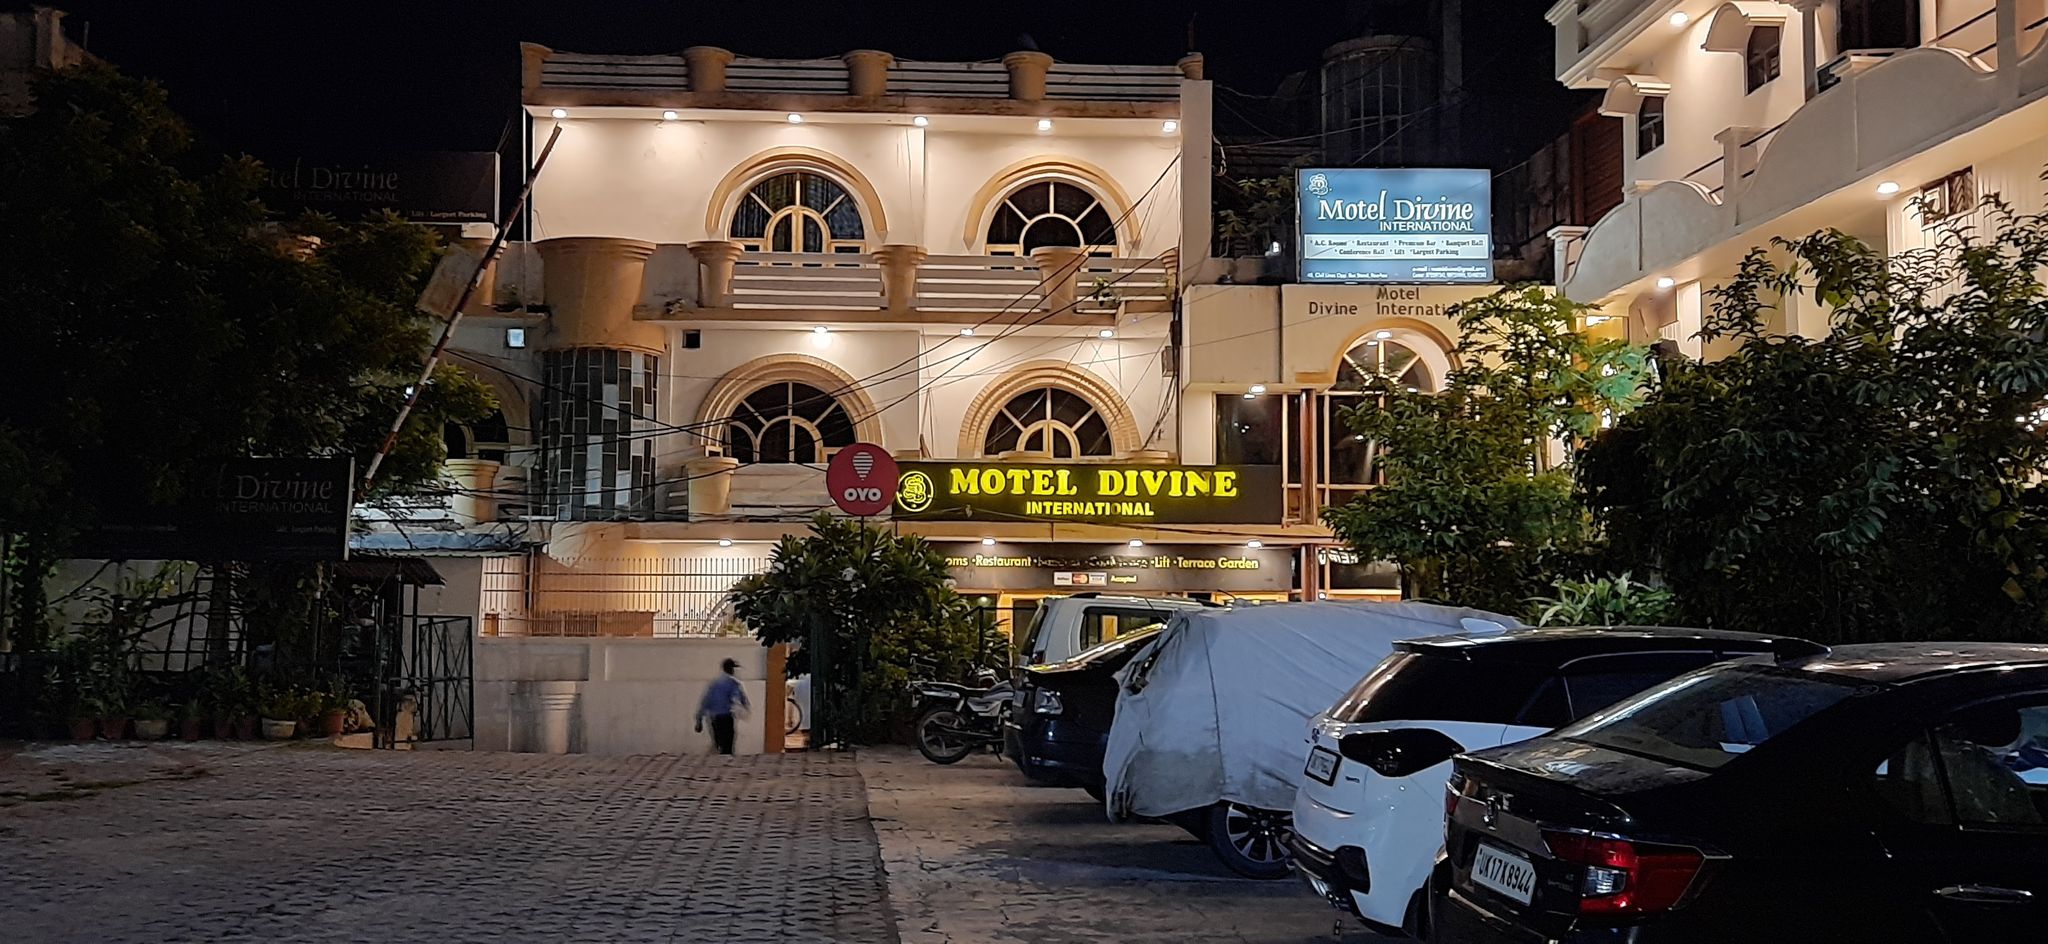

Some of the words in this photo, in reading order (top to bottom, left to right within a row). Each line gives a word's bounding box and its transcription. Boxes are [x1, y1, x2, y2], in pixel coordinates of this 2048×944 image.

[311, 164, 399, 190] Divine
[1318, 189, 1387, 221] Motel
[1393, 195, 1474, 221] Divine
[1380, 221, 1474, 232] INTERNATIONAL
[1376, 287, 1420, 300] Motel
[1308, 301, 1358, 315] Divine
[231, 471, 333, 500] Divine
[950, 468, 1078, 496] MOTEL
[1098, 469, 1238, 498] DIVINE
[844, 487, 882, 502] OYO
[1026, 500, 1154, 516] INTERNATIONAL
[974, 554, 1032, 567] Restaurant
[1154, 556, 1171, 568] Lift
[1176, 557, 1216, 569] Terrace
[1217, 557, 1259, 569] Garden
[1111, 575, 1137, 584] Accepted
